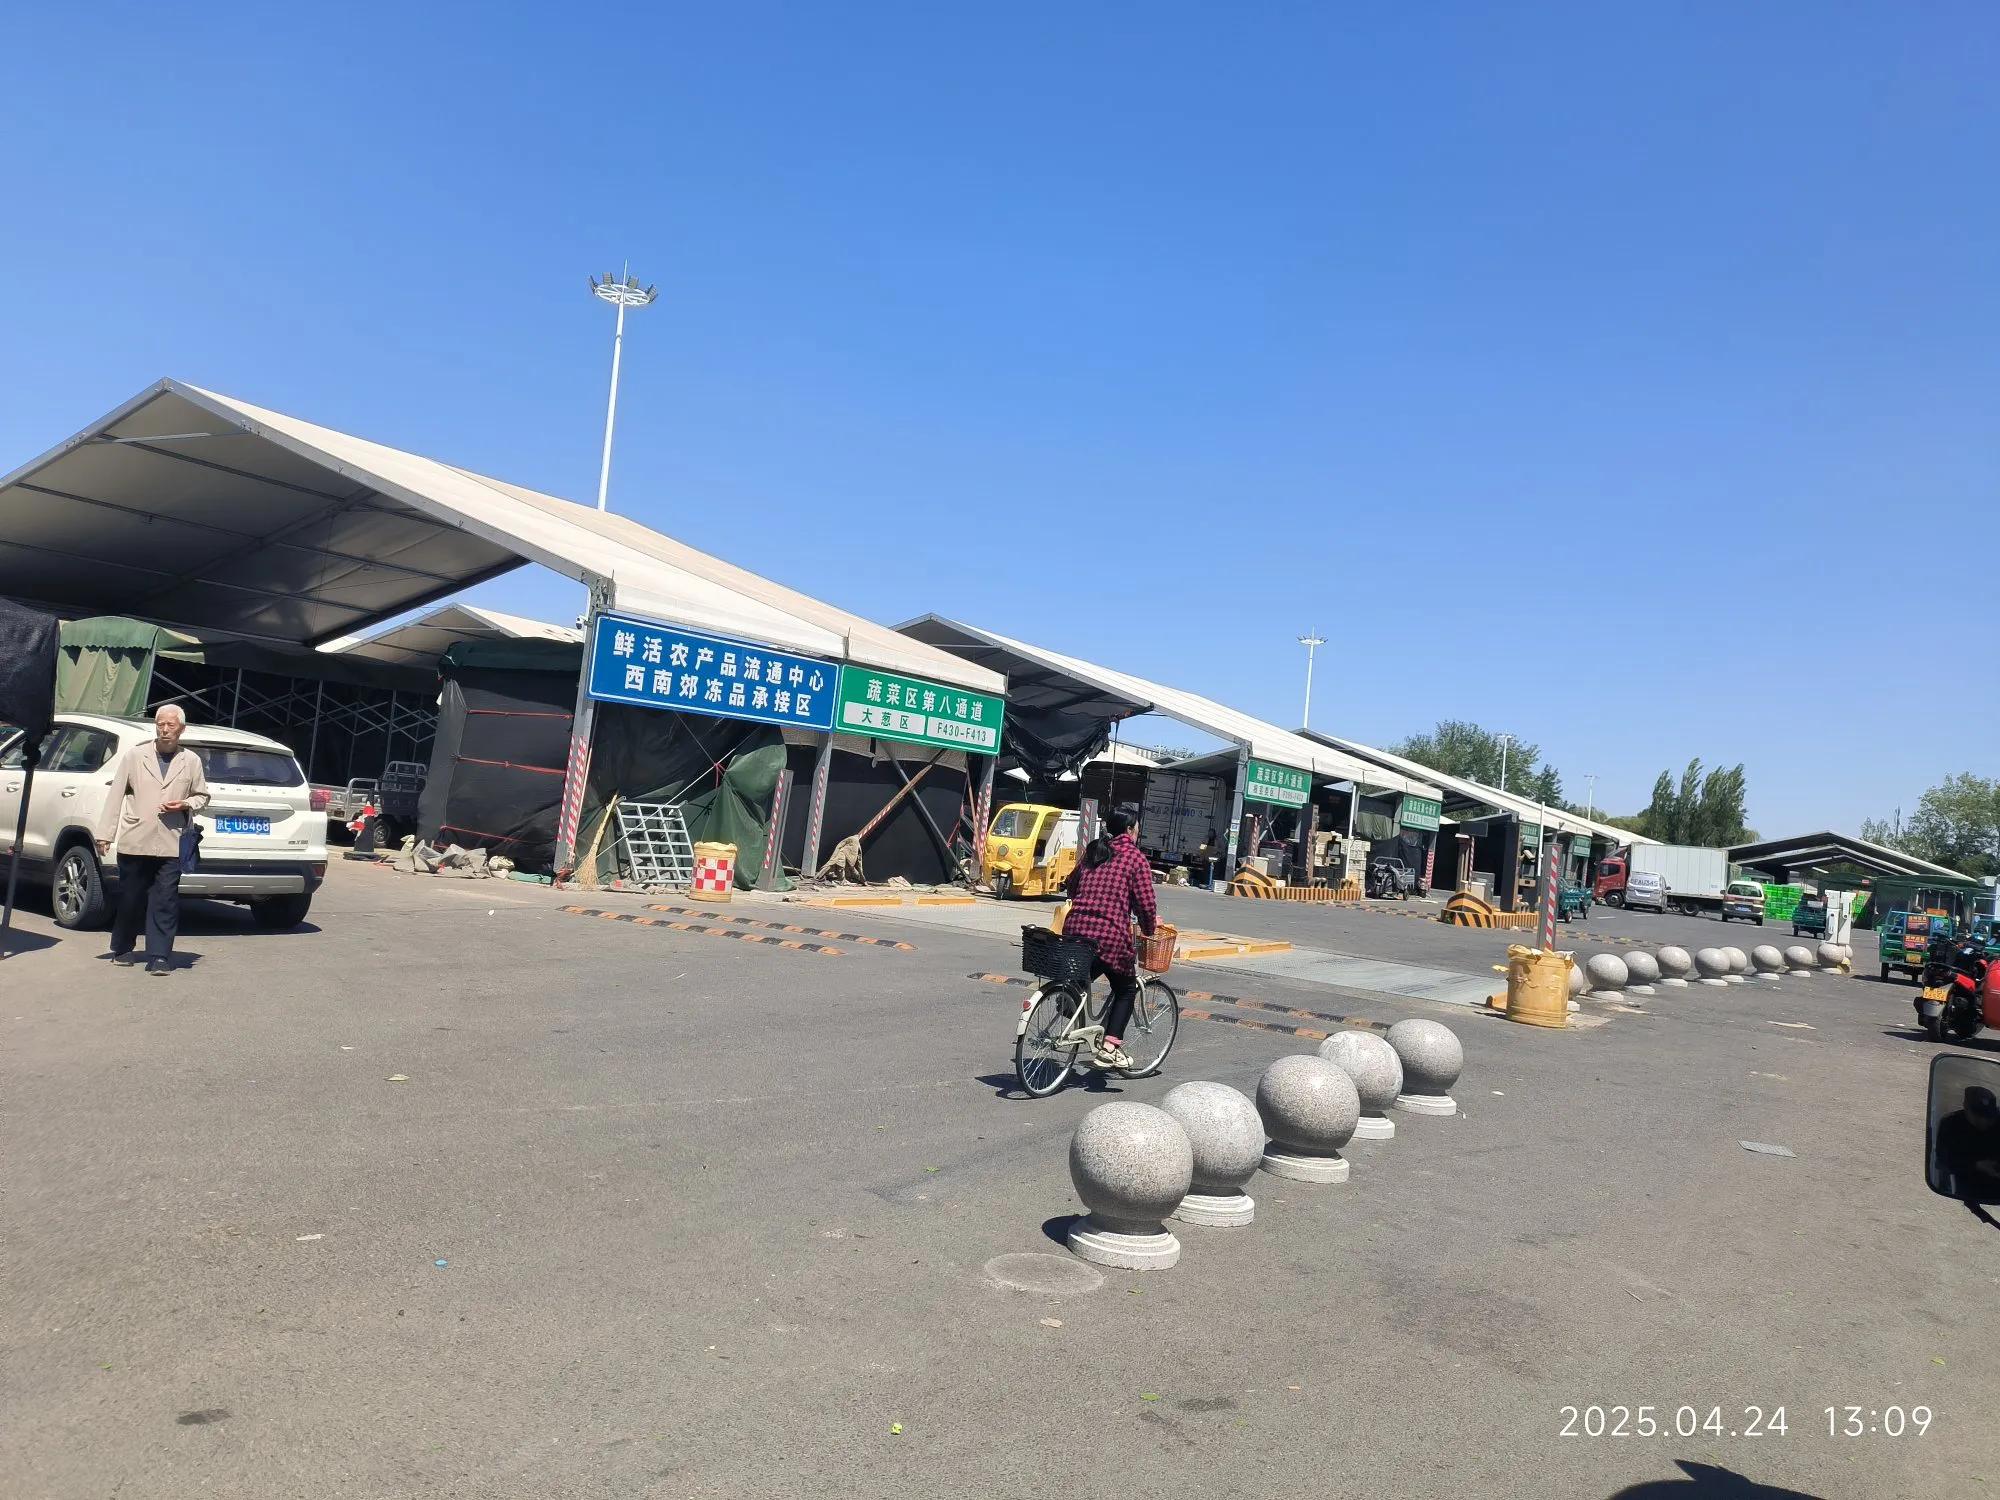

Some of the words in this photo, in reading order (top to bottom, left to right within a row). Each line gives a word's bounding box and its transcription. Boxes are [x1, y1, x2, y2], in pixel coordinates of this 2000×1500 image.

[613, 629, 824, 692] 鲜活农产品流通中心
[625, 663, 812, 716] 西南郊冻品承接区
[866, 678, 984, 722] 蔬菜区第八通道
[861, 707, 910, 730] 大葱区
[937, 721, 987, 742] F430-F413
